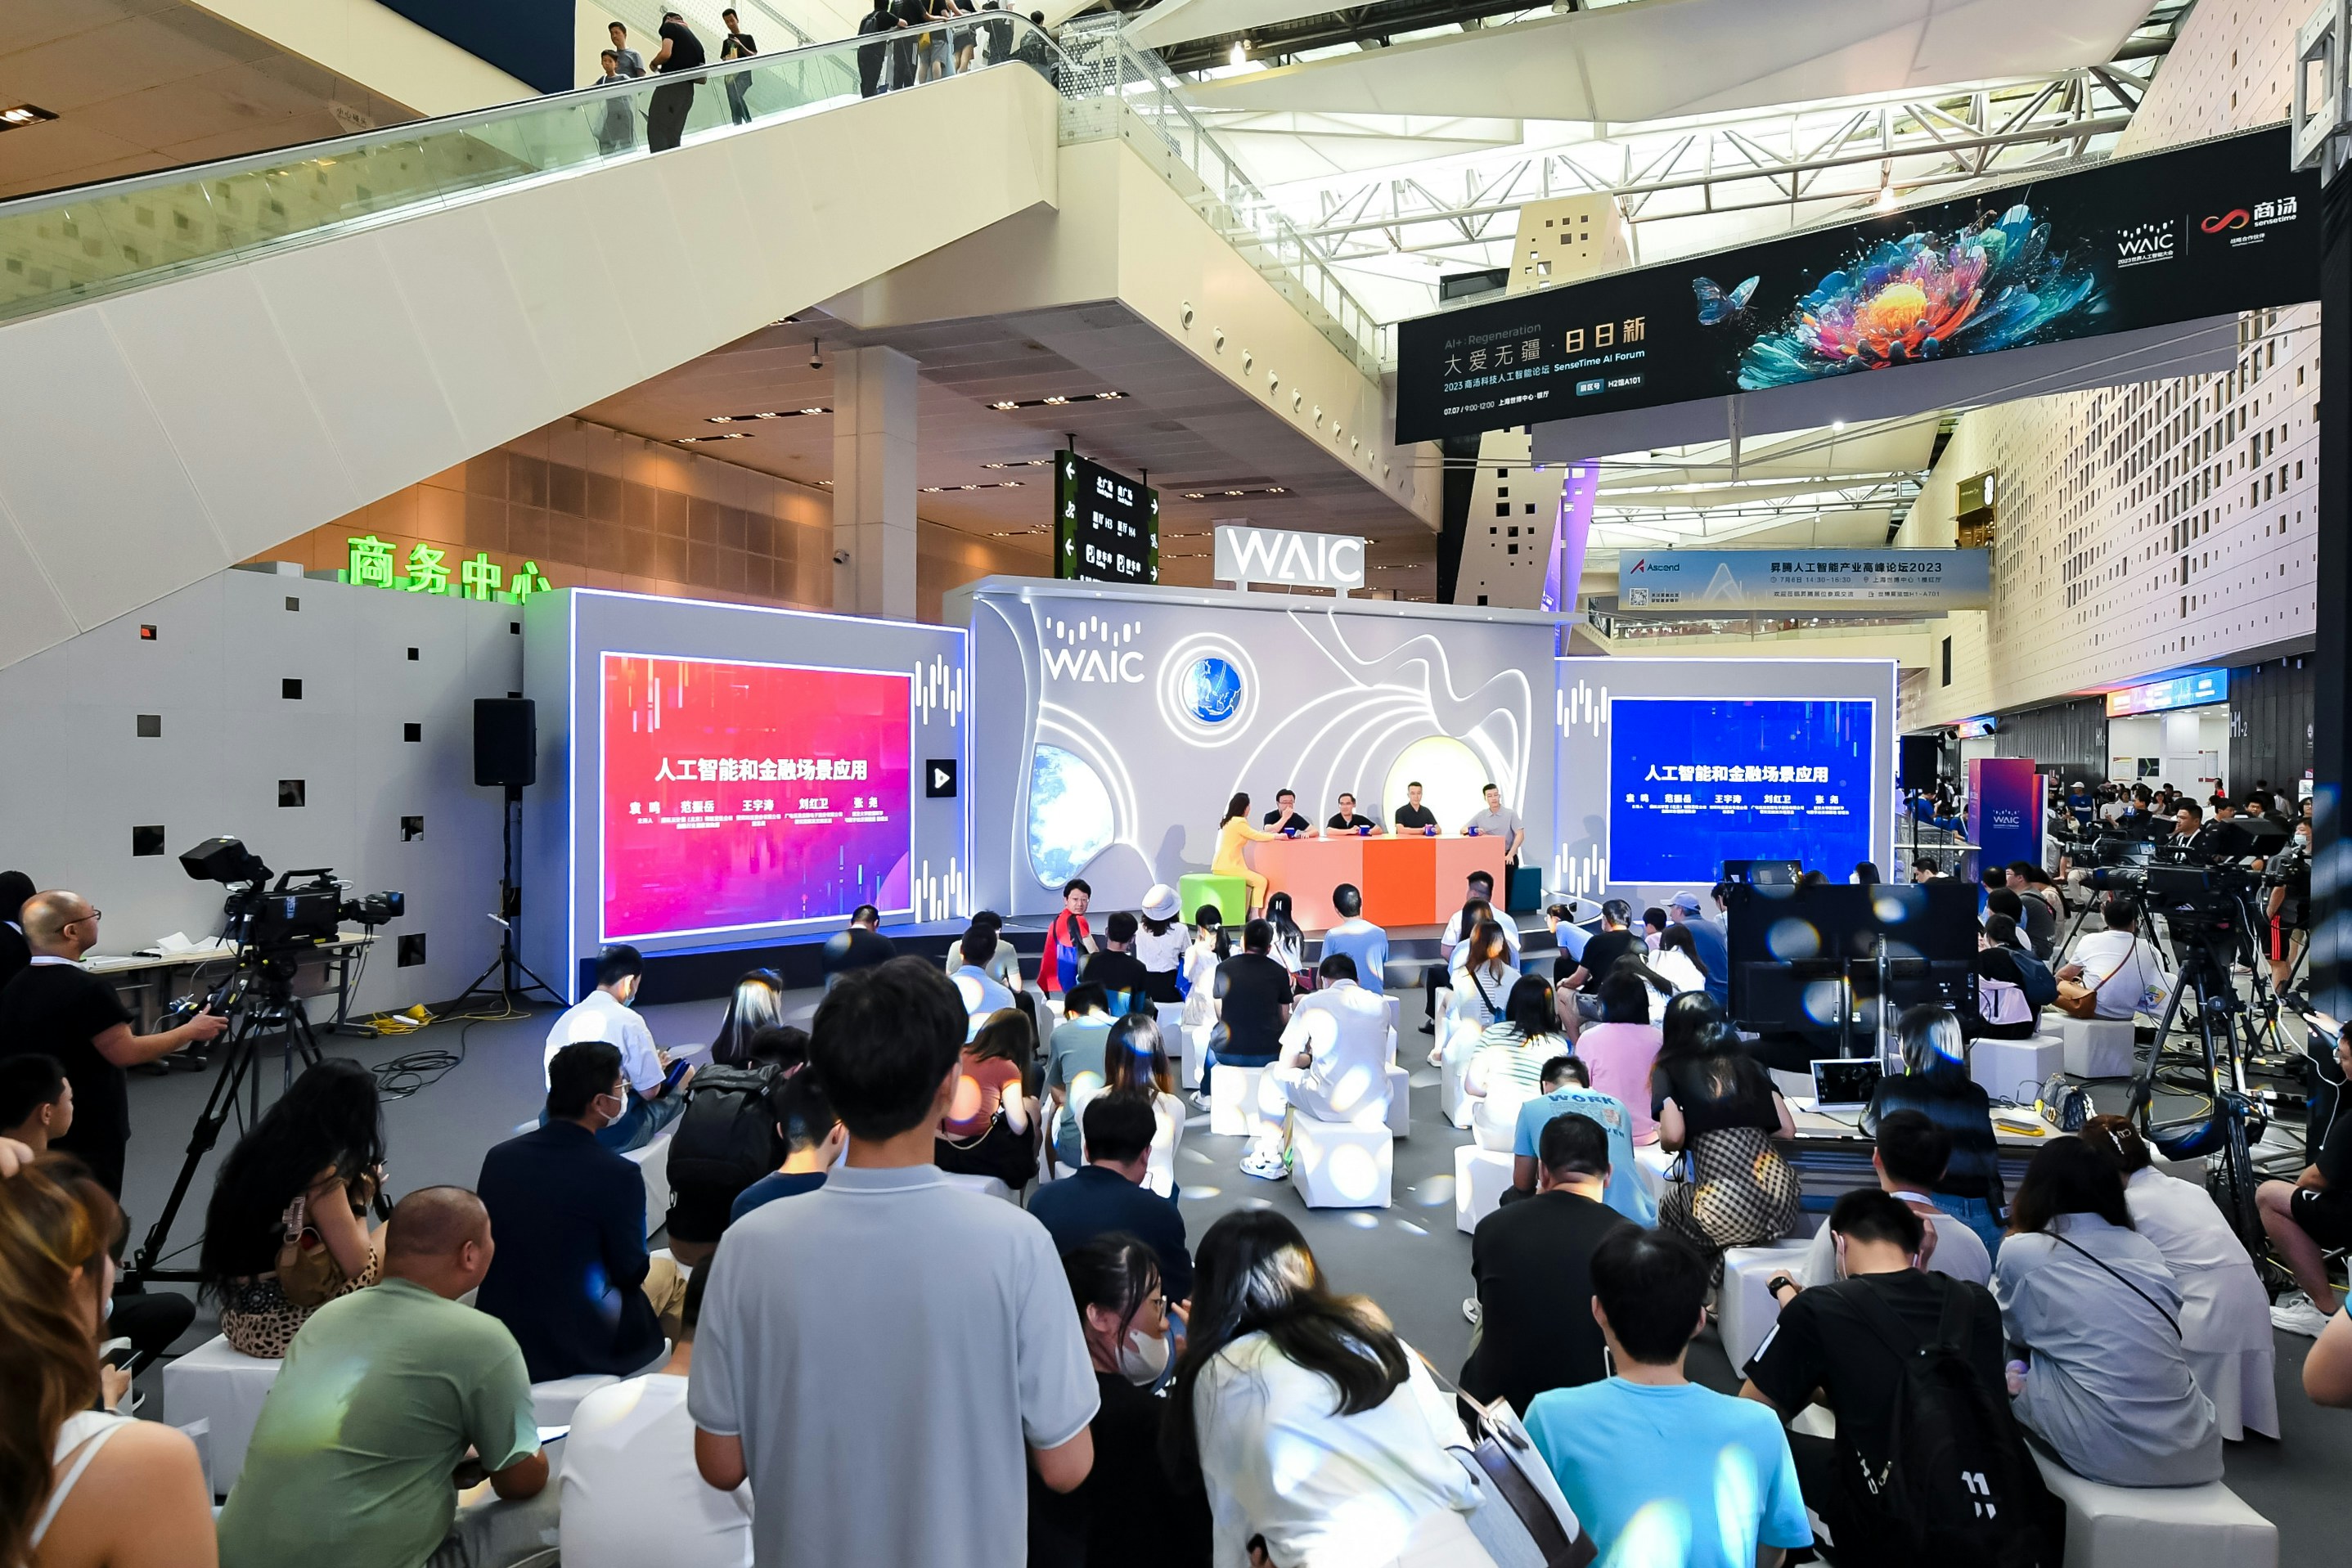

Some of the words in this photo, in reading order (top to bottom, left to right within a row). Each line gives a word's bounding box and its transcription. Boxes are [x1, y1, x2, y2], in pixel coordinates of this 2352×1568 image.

[2254, 196, 2297, 221] 商汤
[2254, 213, 2297, 227] sensetime
[2118, 234, 2174, 256] WAIC
[2117, 249, 2174, 265] 2023世界人工智能大会
[1468, 323, 1541, 346] Regeneration
[1554, 356, 1601, 372] SenseTime
[1603, 355, 1613, 366] AI
[1615, 349, 1645, 365] Forum
[1443, 407, 1460, 416] 07.07
[1104, 517, 1113, 530] H3
[1128, 526, 1137, 538] H4
[1227, 528, 1362, 583] WAIC
[348, 534, 553, 606] 商务中心
[1647, 563, 1680, 572] Ascend
[1770, 562, 1943, 573] 昇腾人工智能产业高峰论坛2023
[1043, 648, 1145, 684] WAIC
[2229, 710, 2248, 738] H1-2
[654, 757, 868, 783] 人工智能和金融场景应用
[1644, 764, 1829, 783] 人工智能和金融场景应用
[798, 797, 830, 811] 刘红卫
[1993, 816, 2020, 824] WAIC
[1548, 1094, 1615, 1106] WORK
